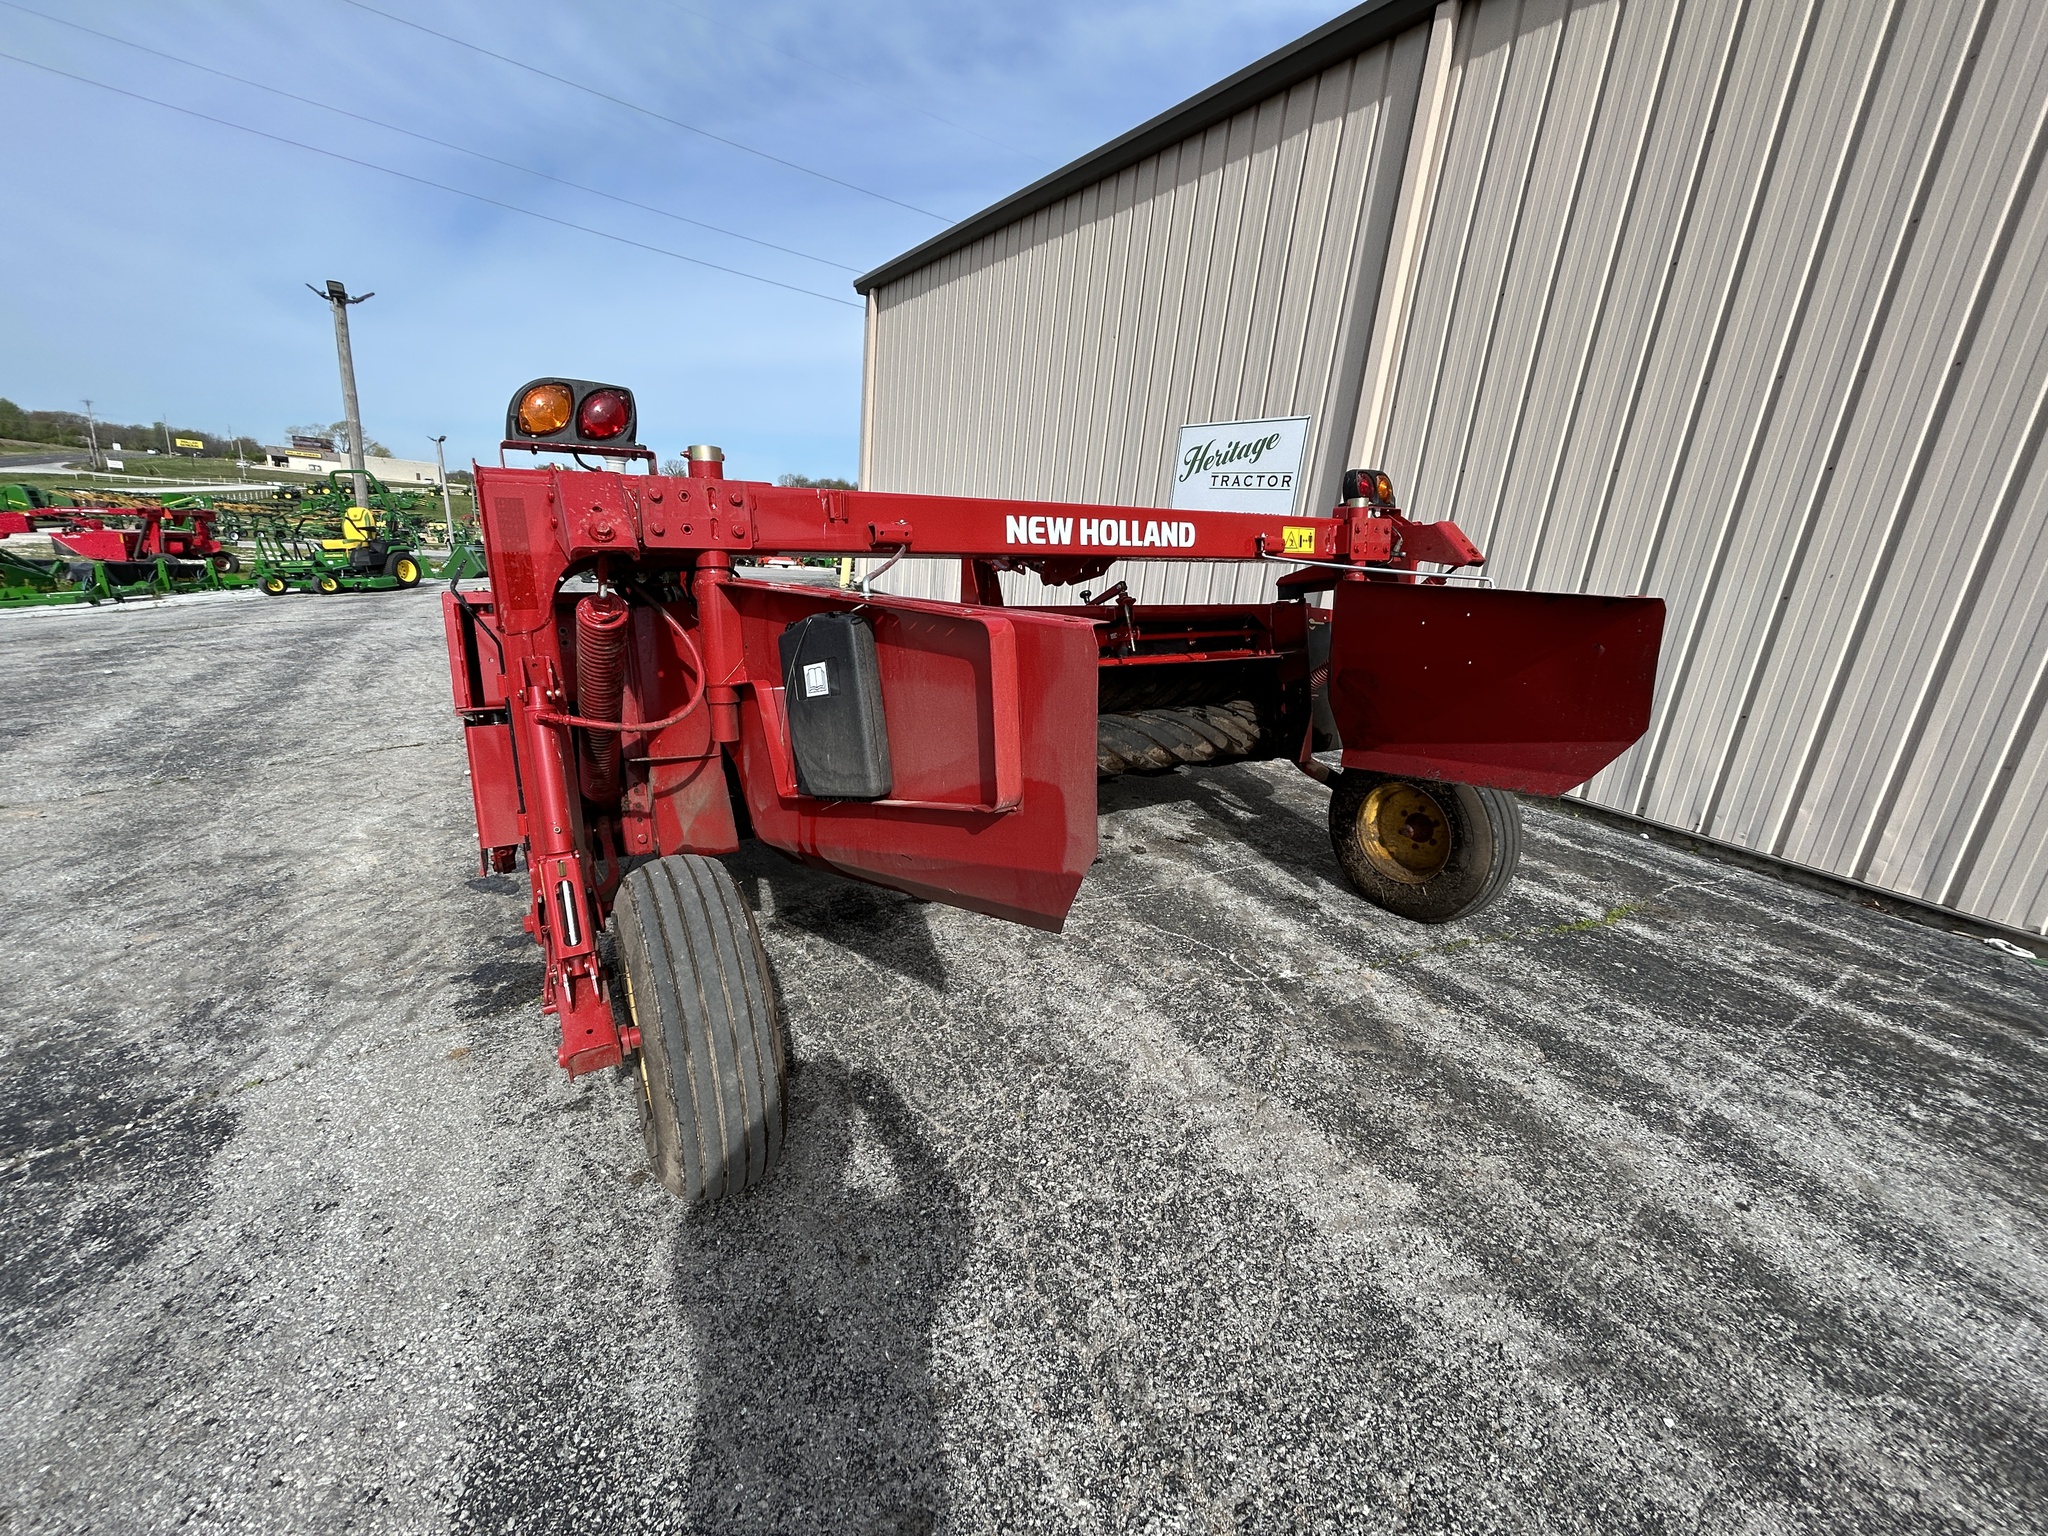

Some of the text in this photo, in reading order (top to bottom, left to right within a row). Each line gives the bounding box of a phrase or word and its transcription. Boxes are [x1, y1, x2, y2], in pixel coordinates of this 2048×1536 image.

[1179, 432, 1281, 482] Heritage
[1211, 475, 1292, 487] TRACTOR
[1006, 515, 1195, 547] NEW HOLLAND
